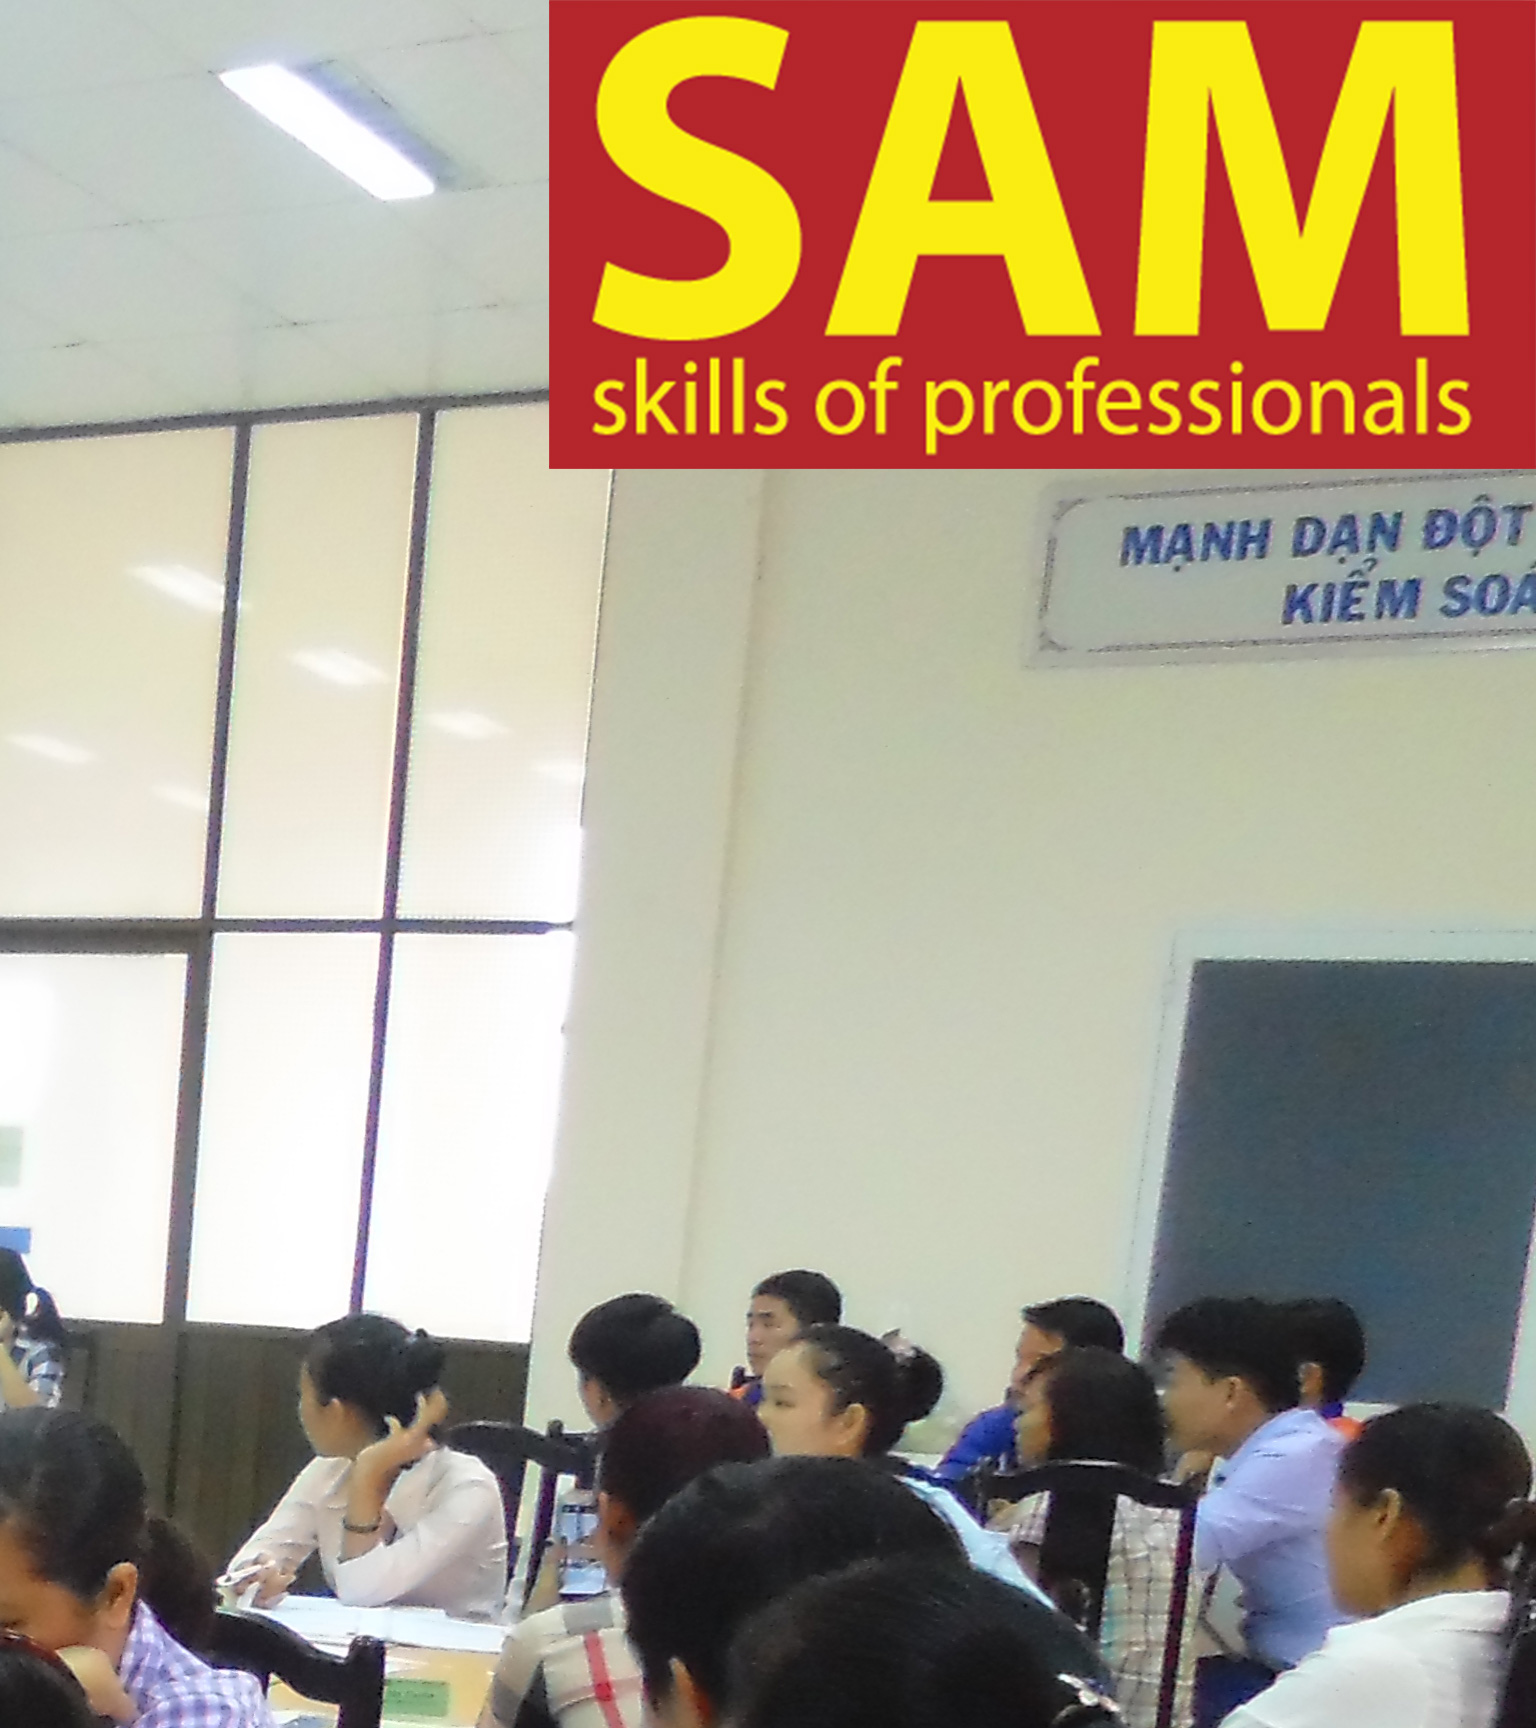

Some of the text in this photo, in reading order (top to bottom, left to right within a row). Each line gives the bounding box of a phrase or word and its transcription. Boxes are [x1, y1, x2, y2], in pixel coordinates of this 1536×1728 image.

[1120, 493, 1534, 573] MẠNH DẠN ĐỘT
[1281, 557, 1424, 625] KIỂM
